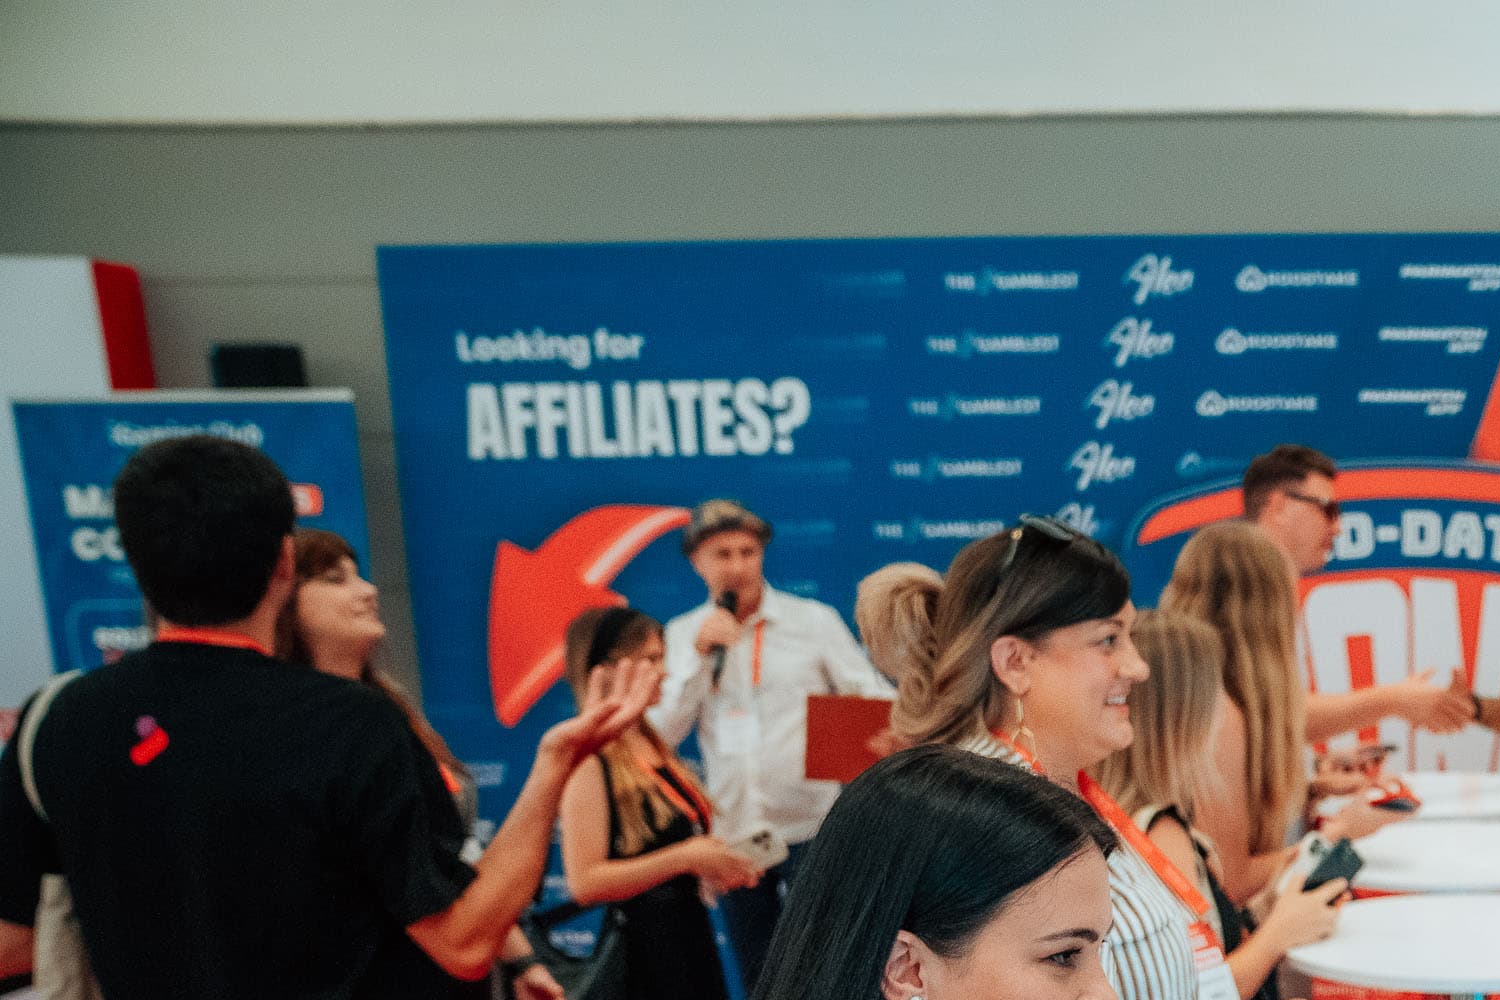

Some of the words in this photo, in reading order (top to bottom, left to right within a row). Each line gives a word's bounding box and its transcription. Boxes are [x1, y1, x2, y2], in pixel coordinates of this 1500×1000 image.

[456, 330, 591, 369] Looking
[594, 329, 643, 359] for
[468, 378, 810, 459] AFFILIATES?
